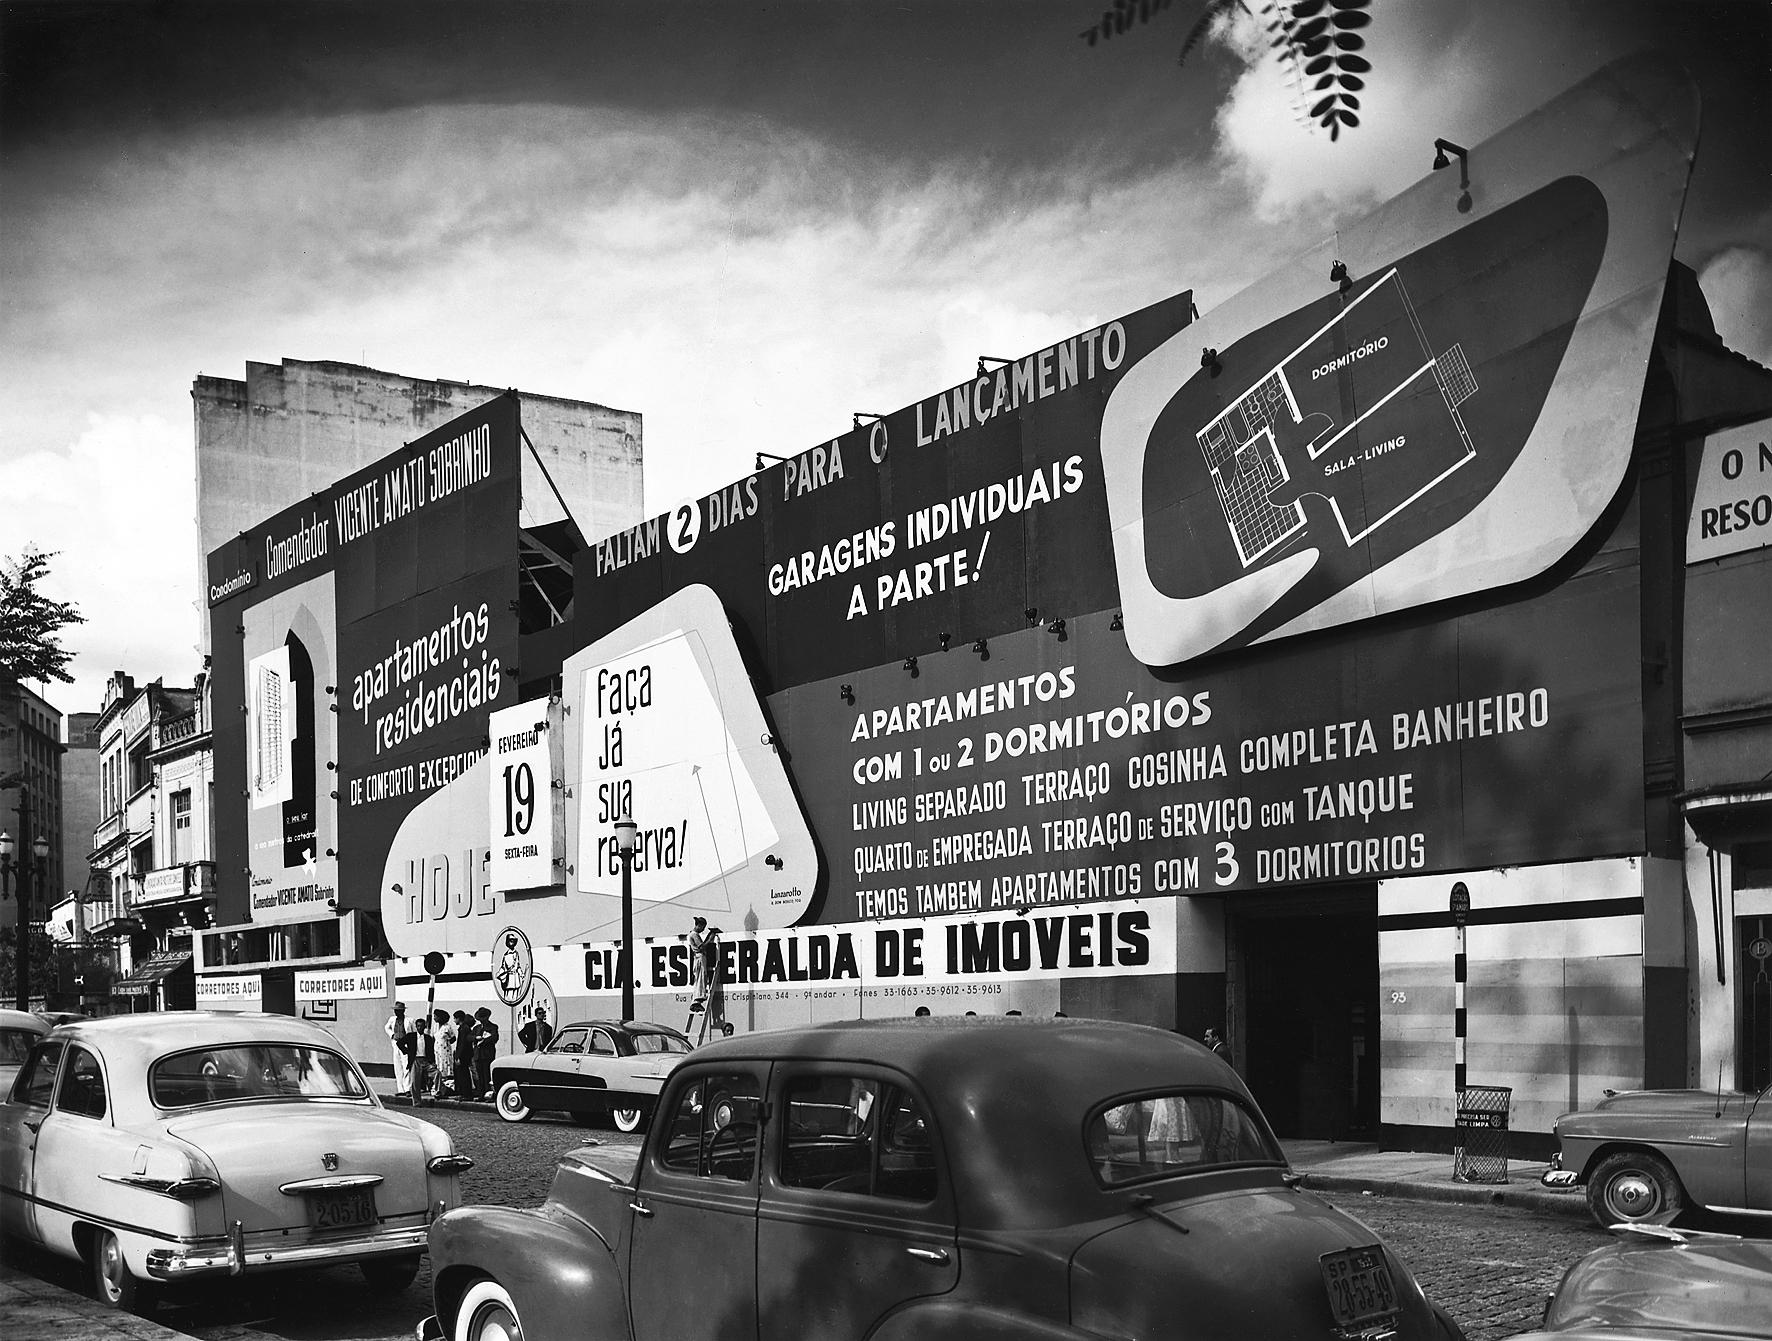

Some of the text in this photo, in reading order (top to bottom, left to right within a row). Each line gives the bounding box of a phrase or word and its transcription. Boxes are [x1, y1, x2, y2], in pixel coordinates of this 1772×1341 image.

[1311, 335, 1389, 380] DORMITÓRIO
[595, 320, 1127, 578] FALTAM 2 DIAS PARA O LANÇAMENTO
[1721, 449, 1744, 481] O
[265, 512, 329, 581] Comendador
[334, 478, 380, 546] VICENTE
[383, 455, 425, 525] AMATO
[429, 423, 491, 502] SOBRINHO
[767, 455, 1084, 598] GARAGENS INDIVIDUAIS
[1701, 494, 1772, 540] RESO
[846, 530, 991, 621] A PARTE!
[353, 603, 489, 725] apartamentos
[598, 664, 653, 718] faça
[375, 649, 500, 755] residenciais
[851, 666, 1076, 743] APARTAMENTOS
[498, 729, 540, 755] FEVEREIRO
[853, 752, 902, 785] COM
[913, 747, 922, 776] 1
[957, 738, 974, 768] 2
[985, 690, 1212, 763] DORMITÓRIOS
[853, 687, 1549, 832] LIVING SEPARADO TERRAÇO COSINHA COMPLETA BANHEIRO
[350, 778, 363, 807] DE
[366, 764, 415, 804] CONFORTO
[502, 762, 535, 837] 19
[598, 779, 632, 823] sua
[504, 845, 539, 860] SEXTA-FEIRA
[598, 819, 688, 878] reerva!
[854, 773, 1414, 882] QUARTO DE EMPREGADA TERRAÇO DE SERVIÇO COM TANQUE
[277, 887, 297, 906] VICENTE
[297, 884, 314, 903] AMATO
[405, 849, 496, 924] HOJE
[856, 833, 1425, 918] TEMOS TAMBEM APARTAMENTOS COM 3 DORMITORIOS
[651, 932, 859, 988] ESERALDA
[876, 927, 925, 978] DE
[945, 911, 1151, 974] IMOVEIS
[196, 980, 260, 996] CORRETORES AQUI
[300, 976, 382, 994] CORRETORES AQUI
[675, 993, 687, 1002] Rua
[775, 991, 789, 1000] 344
[814, 990, 837, 999] andar
[1391, 991, 1406, 1004] 93
[1329, 1261, 1347, 1278] SP
